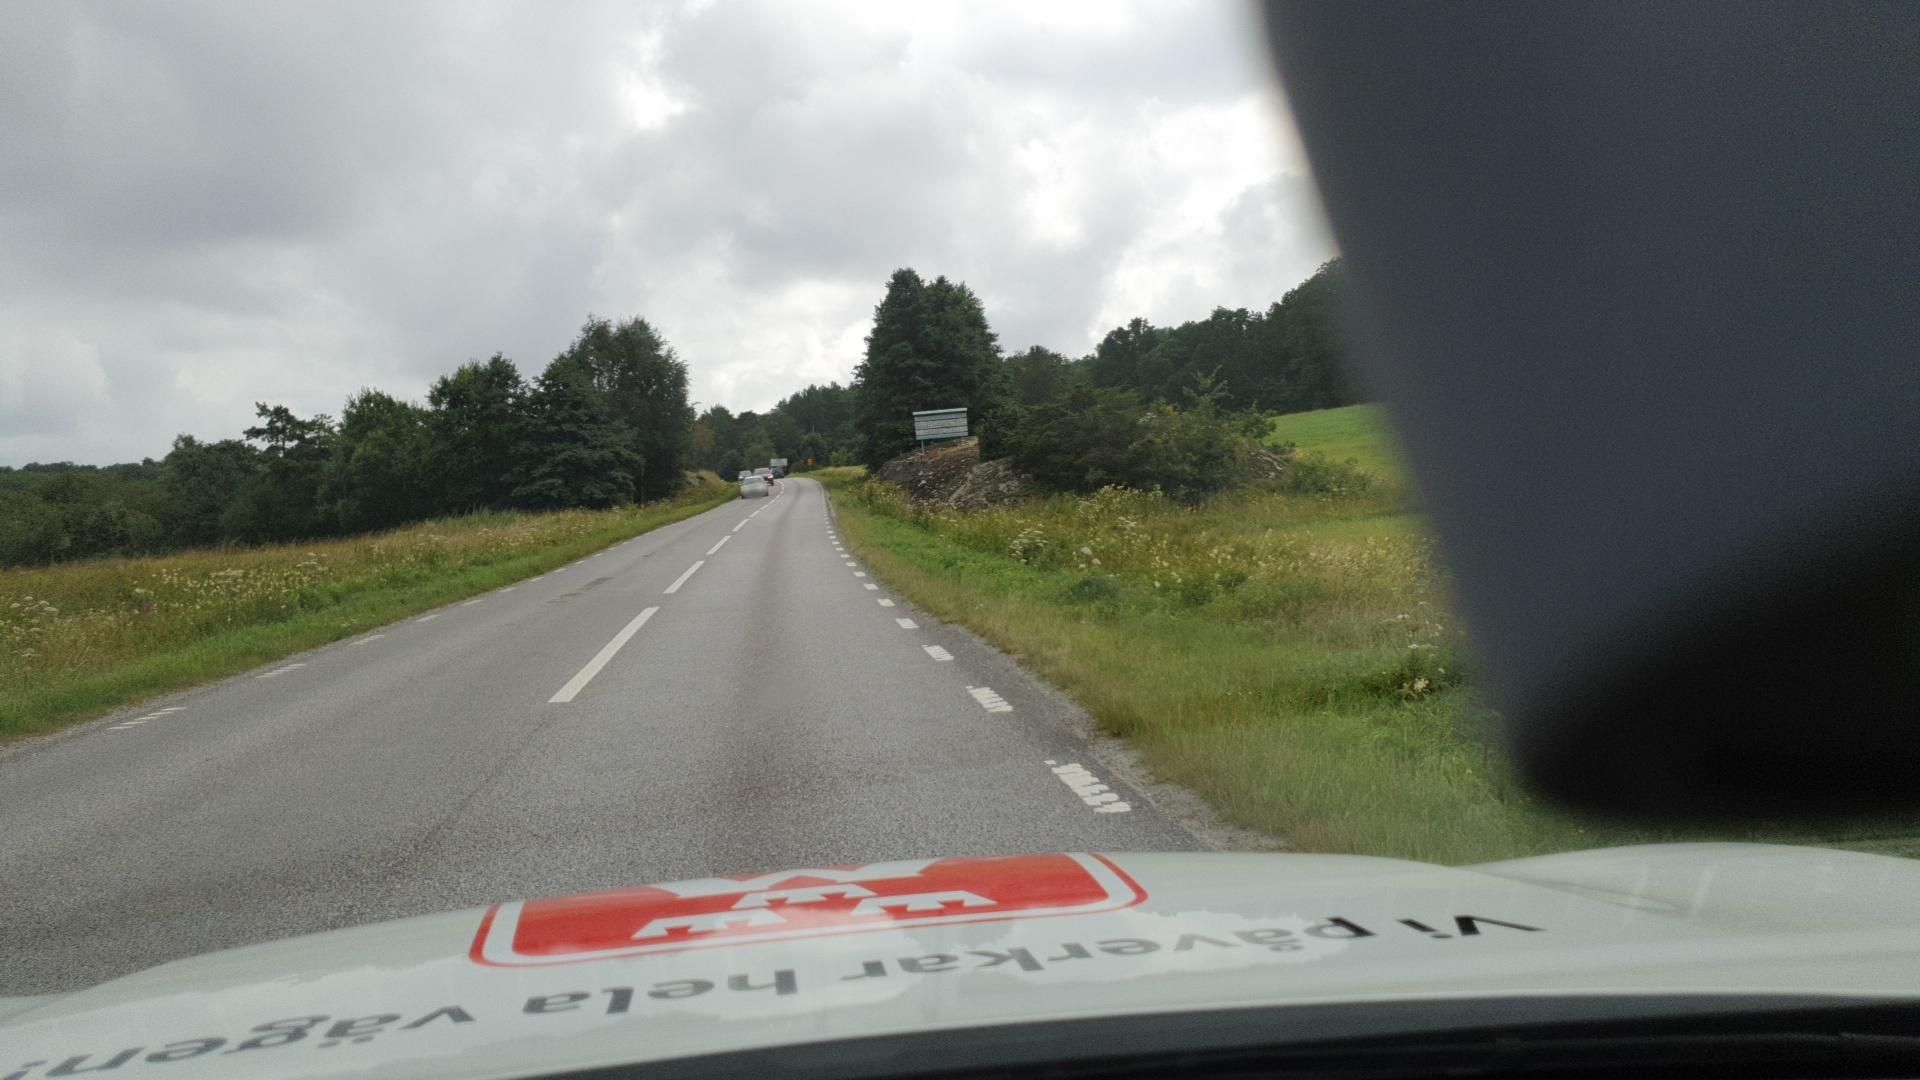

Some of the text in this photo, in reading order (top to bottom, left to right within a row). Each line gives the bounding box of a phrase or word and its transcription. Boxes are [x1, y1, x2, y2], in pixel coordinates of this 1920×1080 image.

[840, 917, 1376, 981] påverkar
[1396, 915, 1546, 939] Vi
[522, 969, 797, 1014] hela
